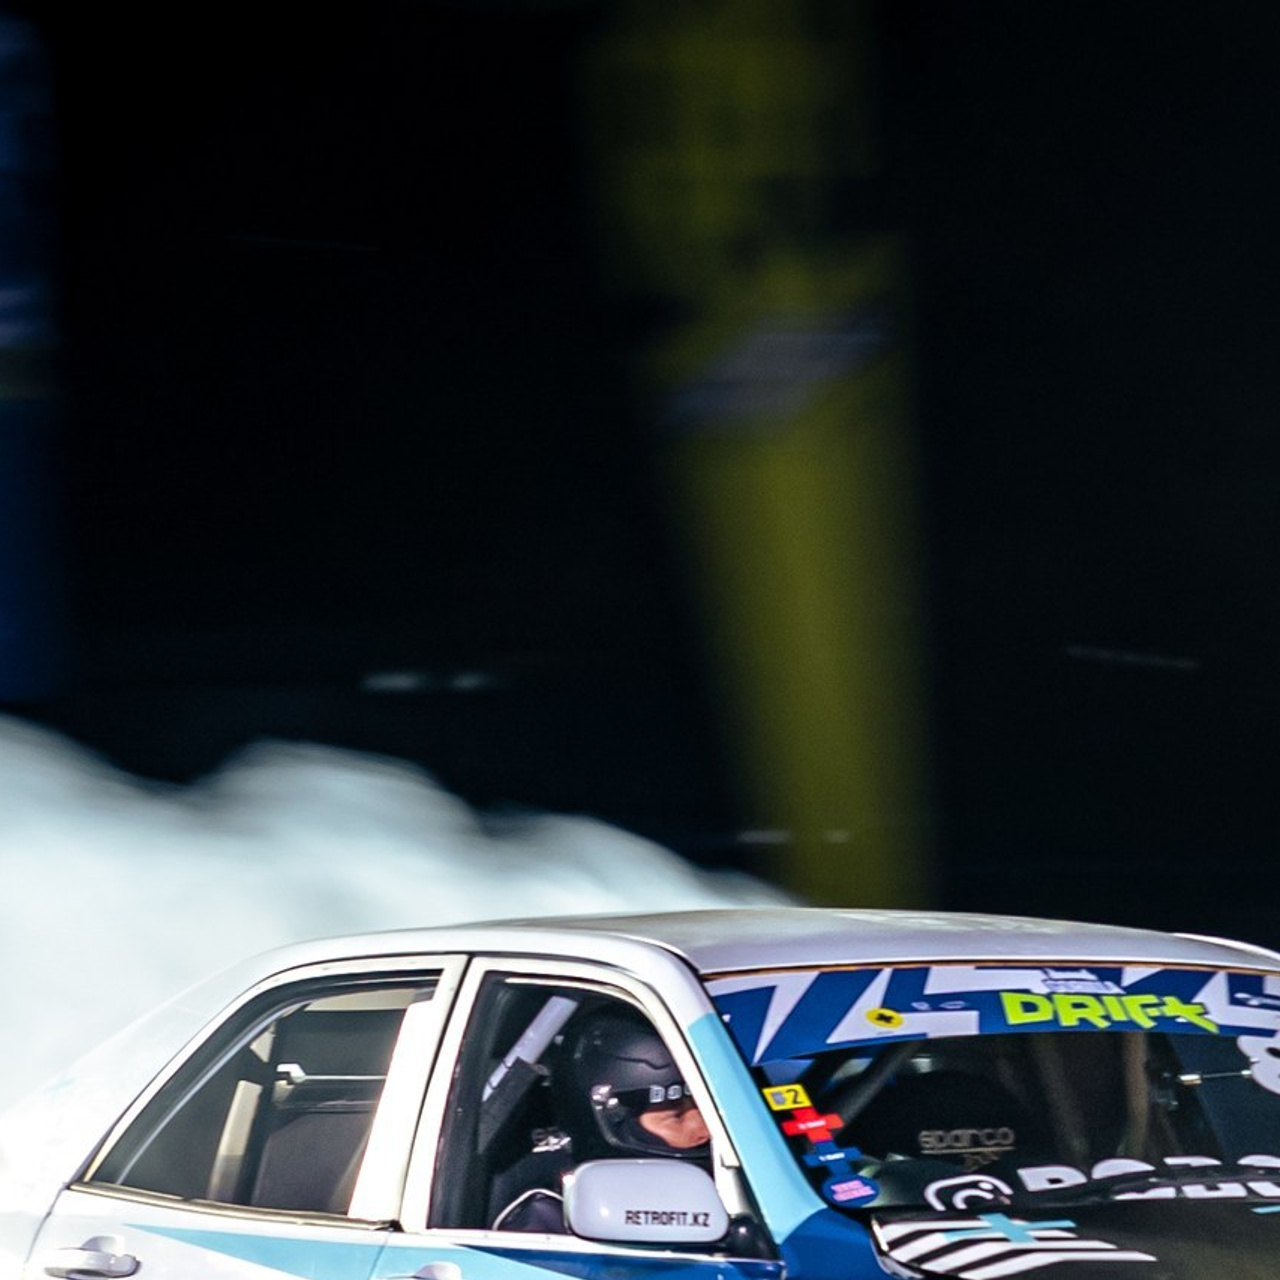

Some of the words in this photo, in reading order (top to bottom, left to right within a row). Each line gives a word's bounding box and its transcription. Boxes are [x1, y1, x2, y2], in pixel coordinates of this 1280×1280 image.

[1000, 991, 1219, 1034] DRIFT
[786, 1088, 804, 1105] 2
[919, 1127, 1016, 1152] sparco
[624, 1210, 711, 1228] RETROFIT.KZ
